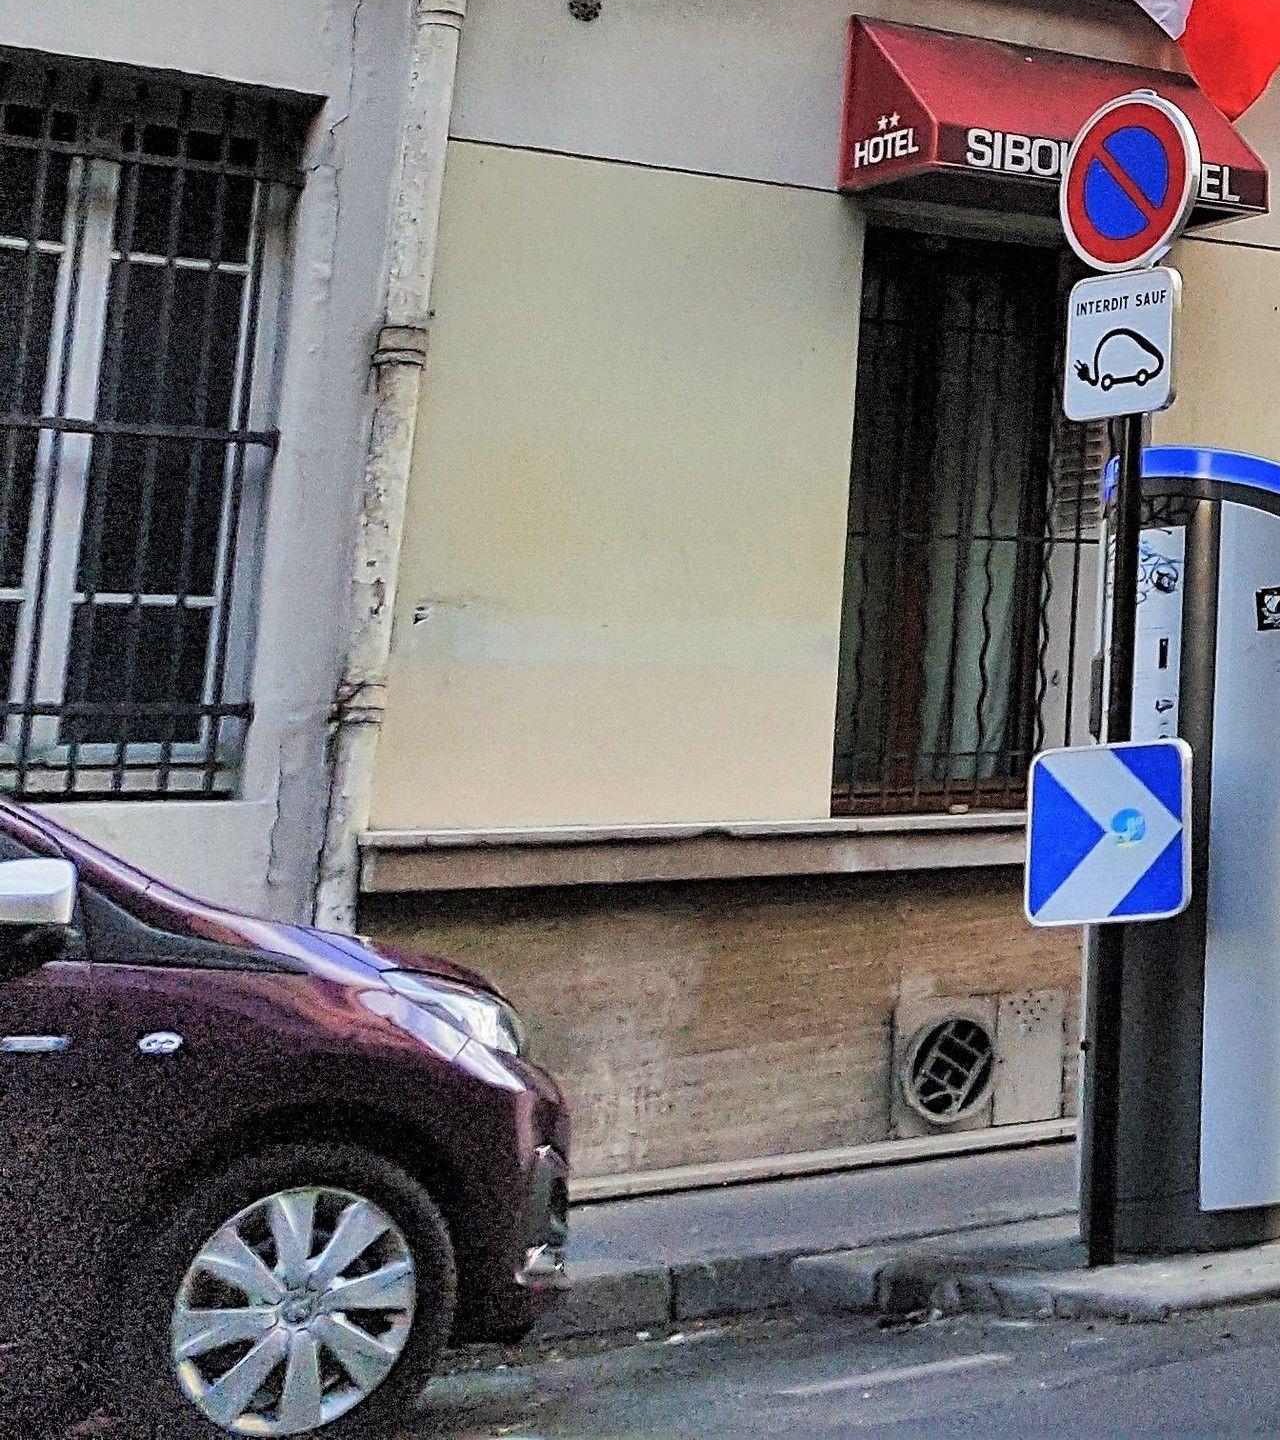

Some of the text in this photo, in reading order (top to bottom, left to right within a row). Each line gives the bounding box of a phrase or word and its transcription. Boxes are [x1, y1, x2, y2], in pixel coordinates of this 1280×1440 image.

[854, 128, 919, 168] HOTEL
[967, 128, 1072, 176] SIBO
[1076, 290, 1166, 316] INTERDIT SAUF
